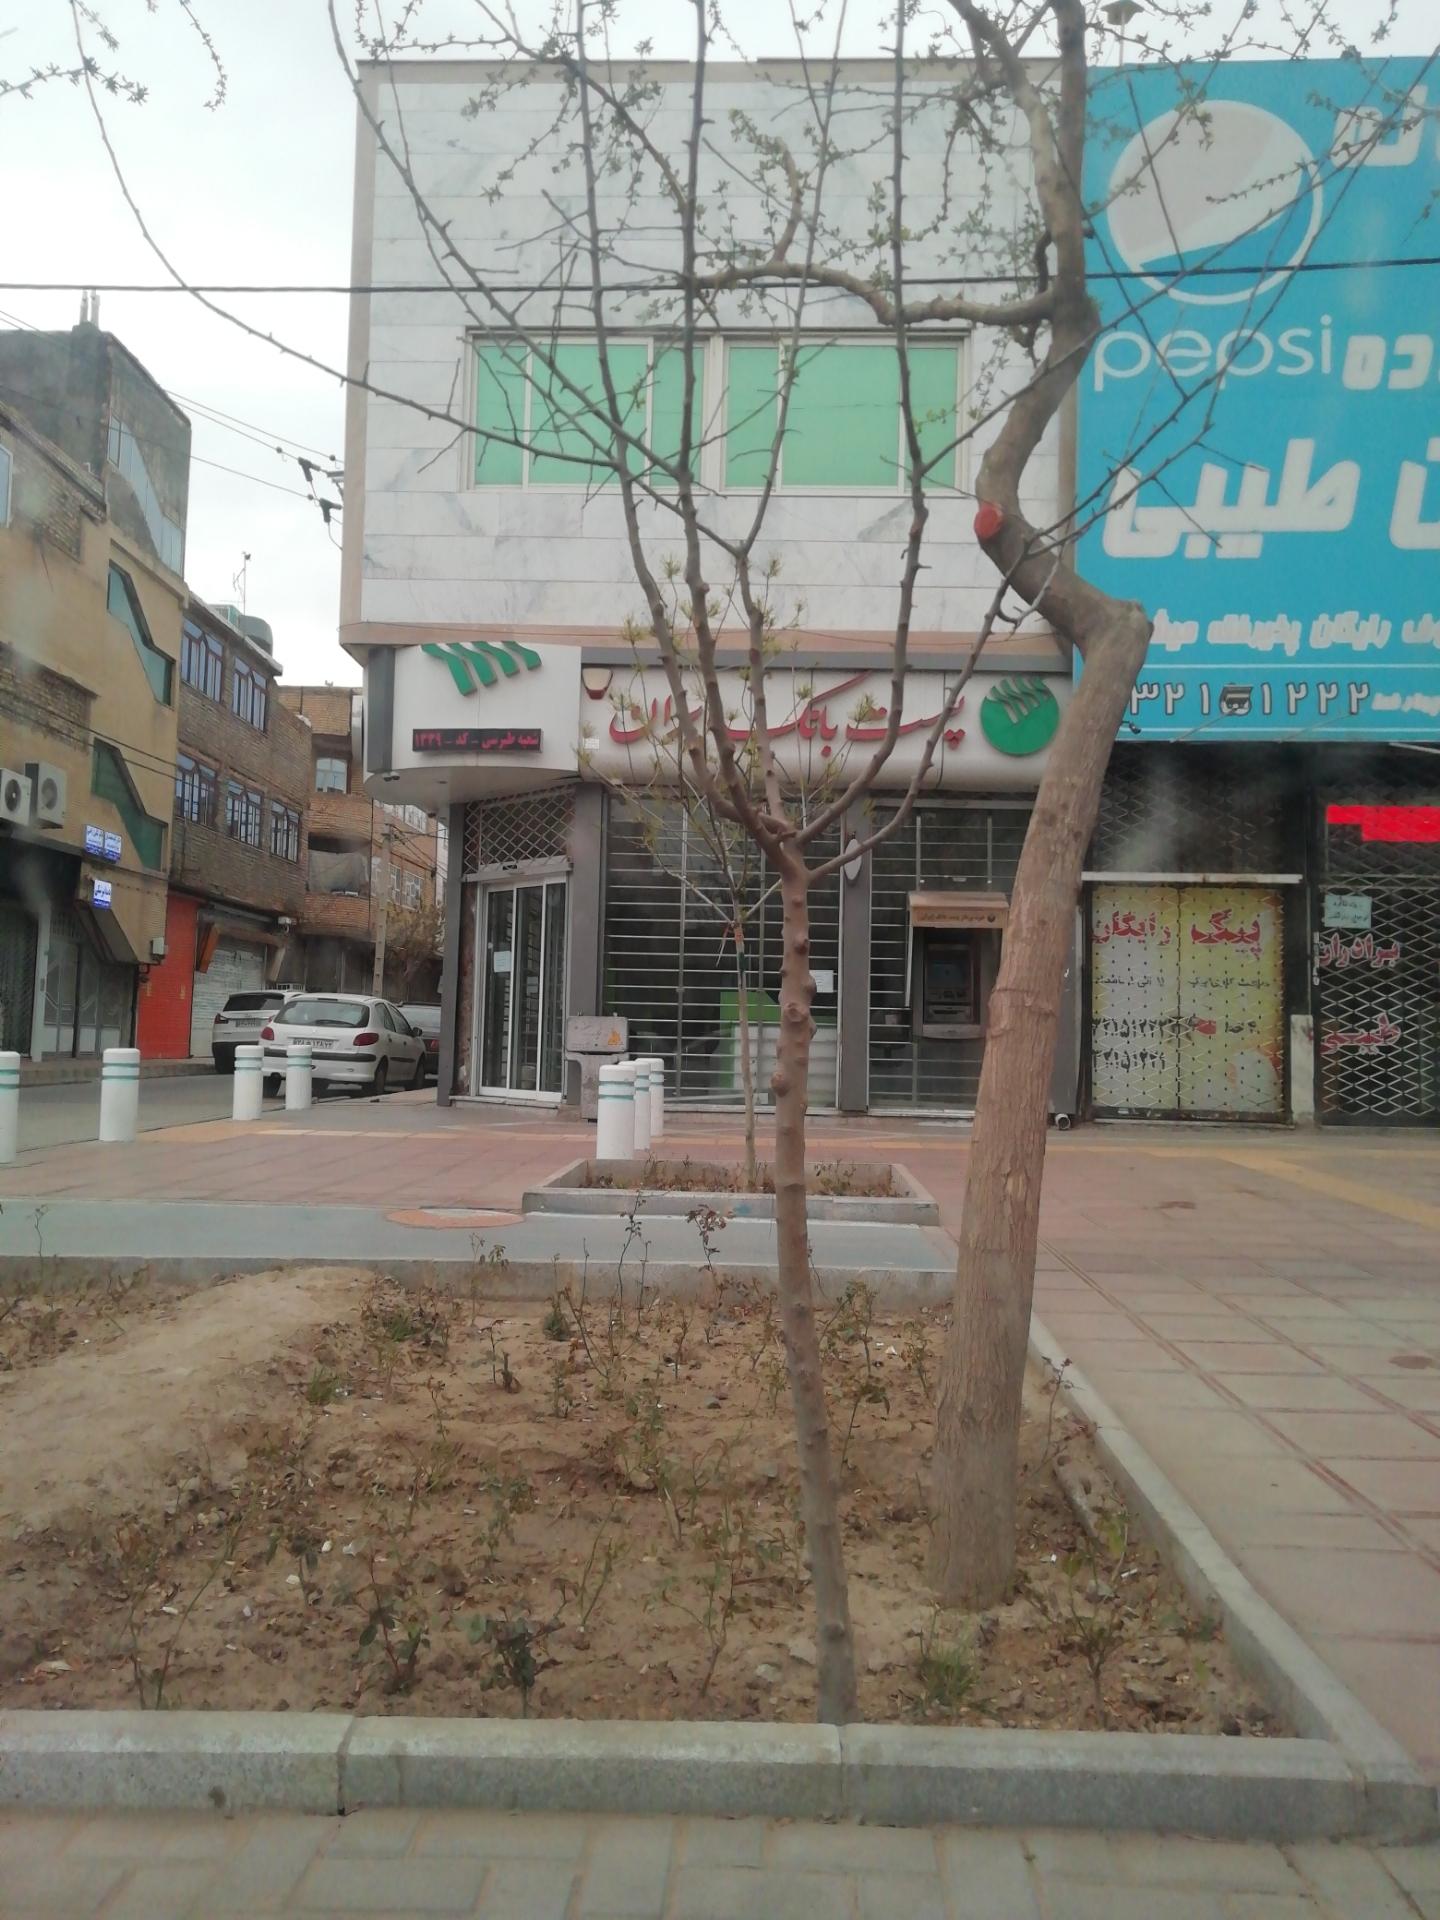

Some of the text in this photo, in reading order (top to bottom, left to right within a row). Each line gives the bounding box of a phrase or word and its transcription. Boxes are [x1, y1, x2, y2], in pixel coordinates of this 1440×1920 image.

[1093, 314, 1333, 393] pepsi
[1102, 438, 1361, 560] طیبی
[1091, 908, 1263, 957] پیک رایگان
[1320, 1013, 1401, 1055] طیبی
